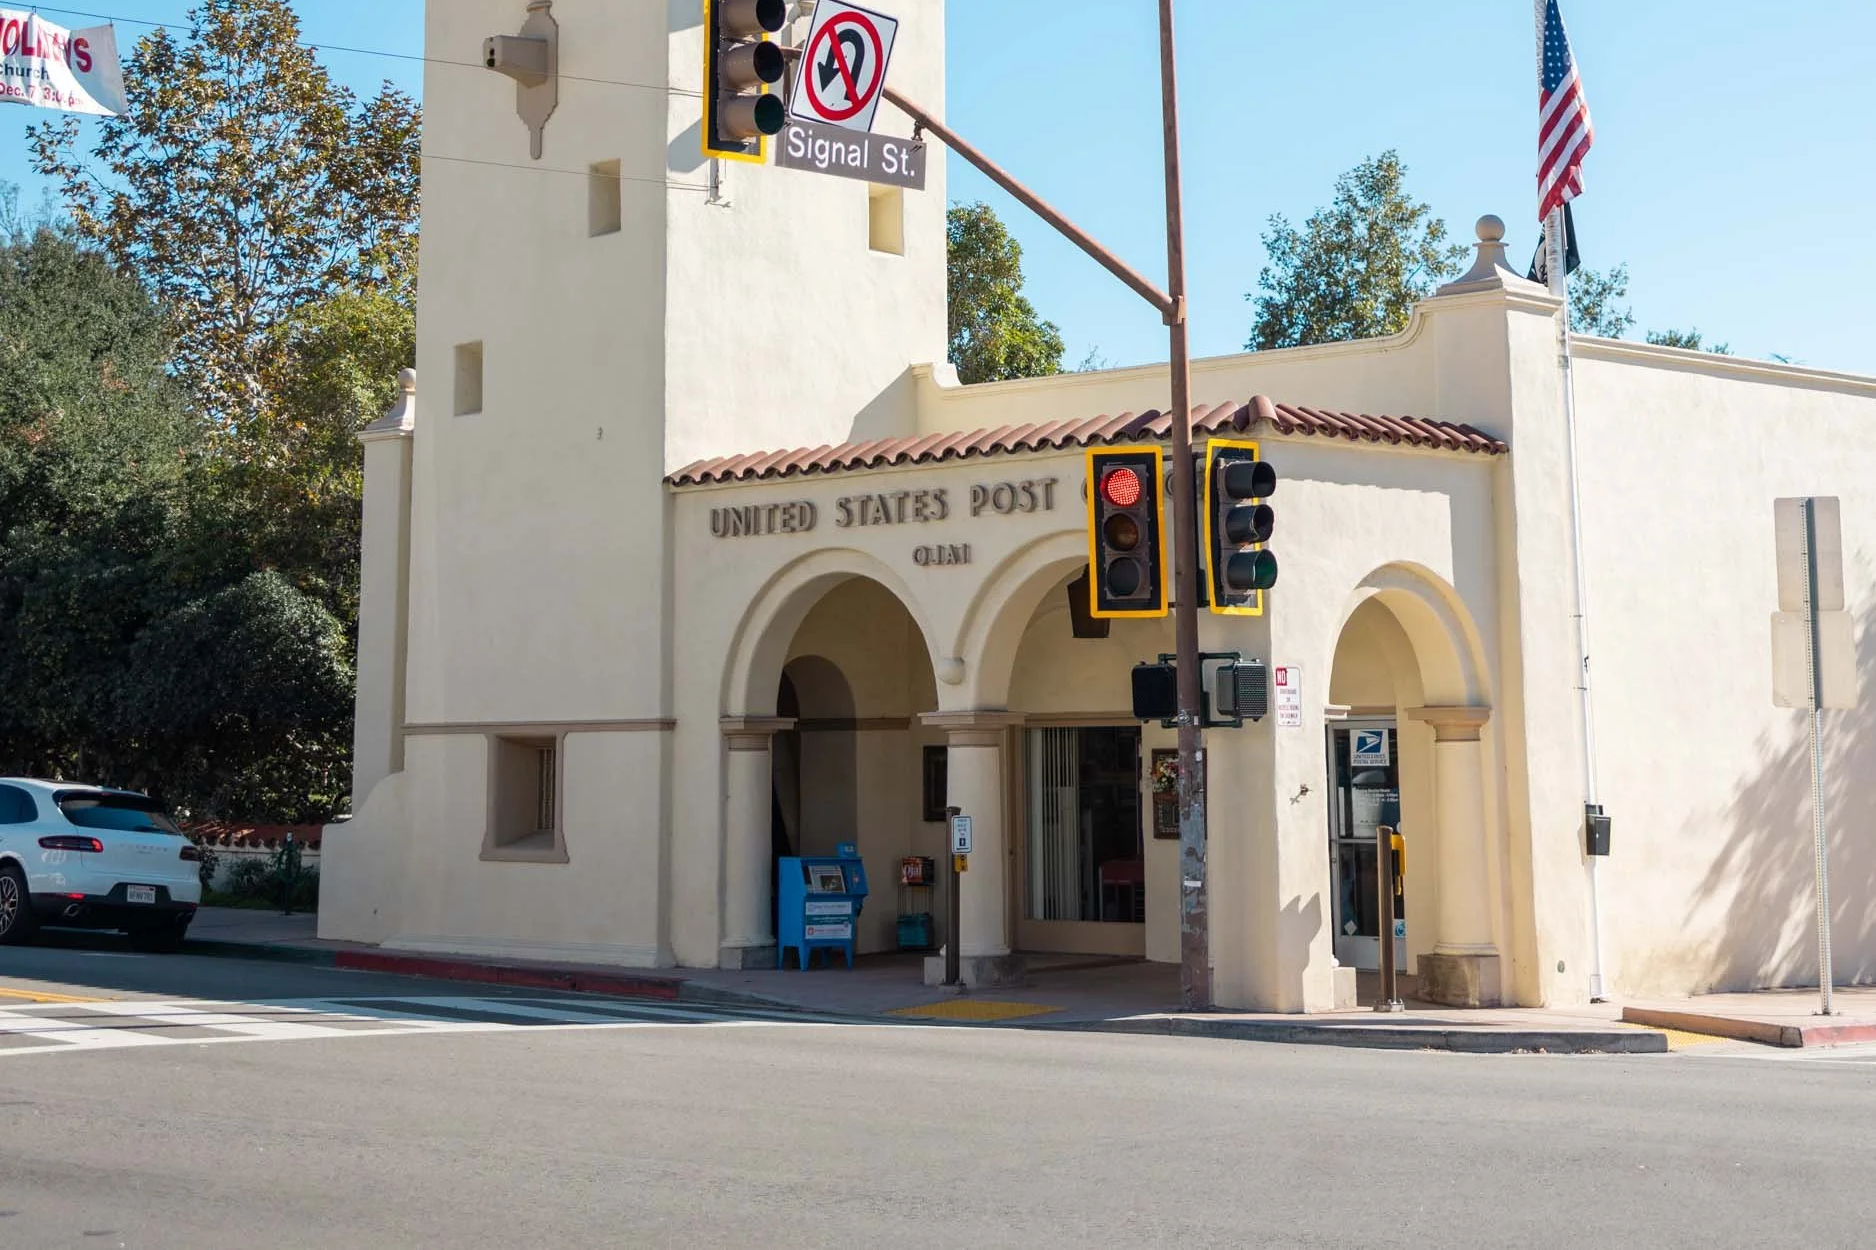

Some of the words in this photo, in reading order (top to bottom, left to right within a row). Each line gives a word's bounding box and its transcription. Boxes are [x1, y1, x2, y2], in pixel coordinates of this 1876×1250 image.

[787, 126, 869, 169] Signal
[881, 143, 916, 177] St.
[710, 500, 818, 538] UNITED
[835, 489, 949, 527] STATES
[969, 478, 1059, 517] POST
[912, 543, 972, 567] OJAI
[1277, 670, 1286, 685] NO
